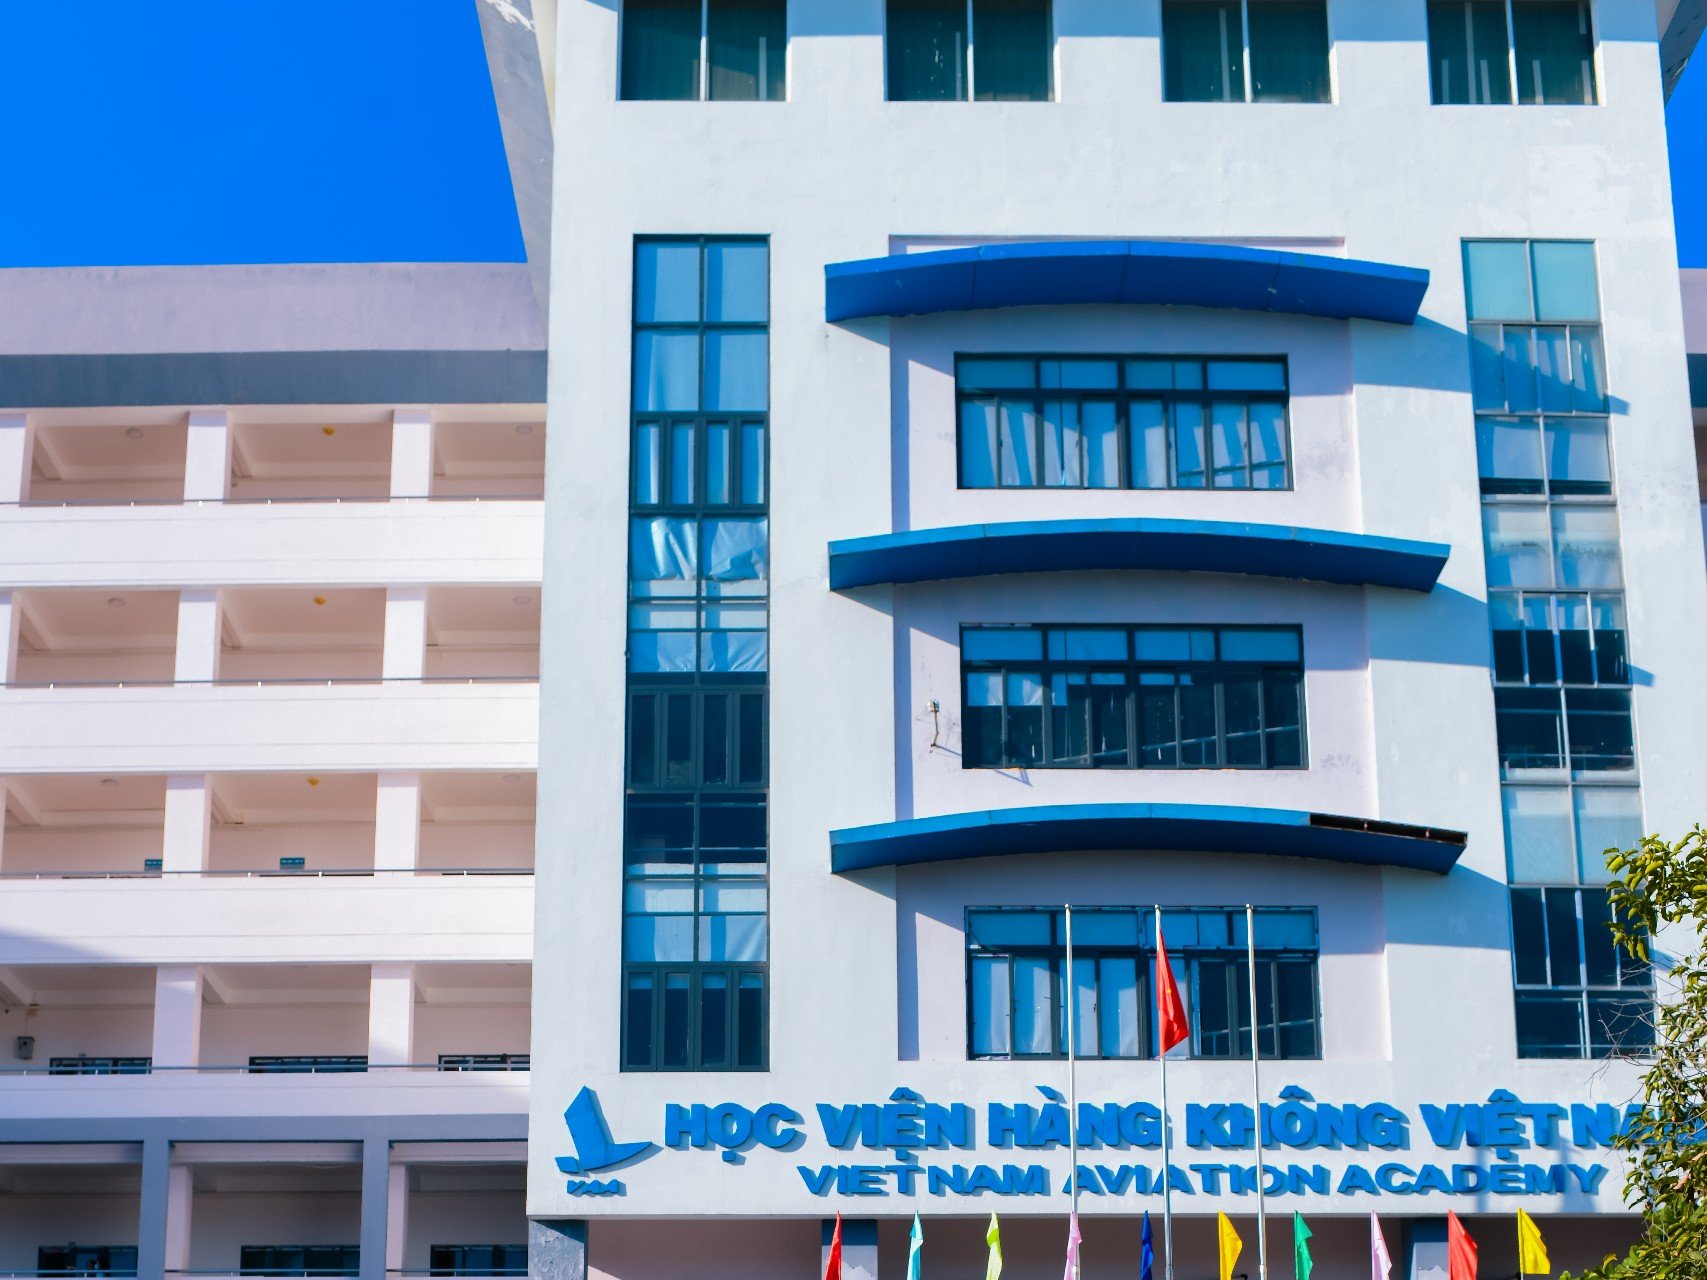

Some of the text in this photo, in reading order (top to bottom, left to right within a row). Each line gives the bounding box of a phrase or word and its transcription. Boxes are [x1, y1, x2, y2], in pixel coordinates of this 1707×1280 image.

[664, 1102, 800, 1162] HỌC
[816, 1086, 966, 1161] VIỆN
[988, 1085, 1164, 1147] HÀNG
[1185, 1085, 1405, 1148] KHÔNG
[1418, 1088, 1560, 1161] VIỆT
[566, 1178, 620, 1195] VAA
[796, 1163, 1602, 1194] VIETNAM AVIATION ACADEMY
